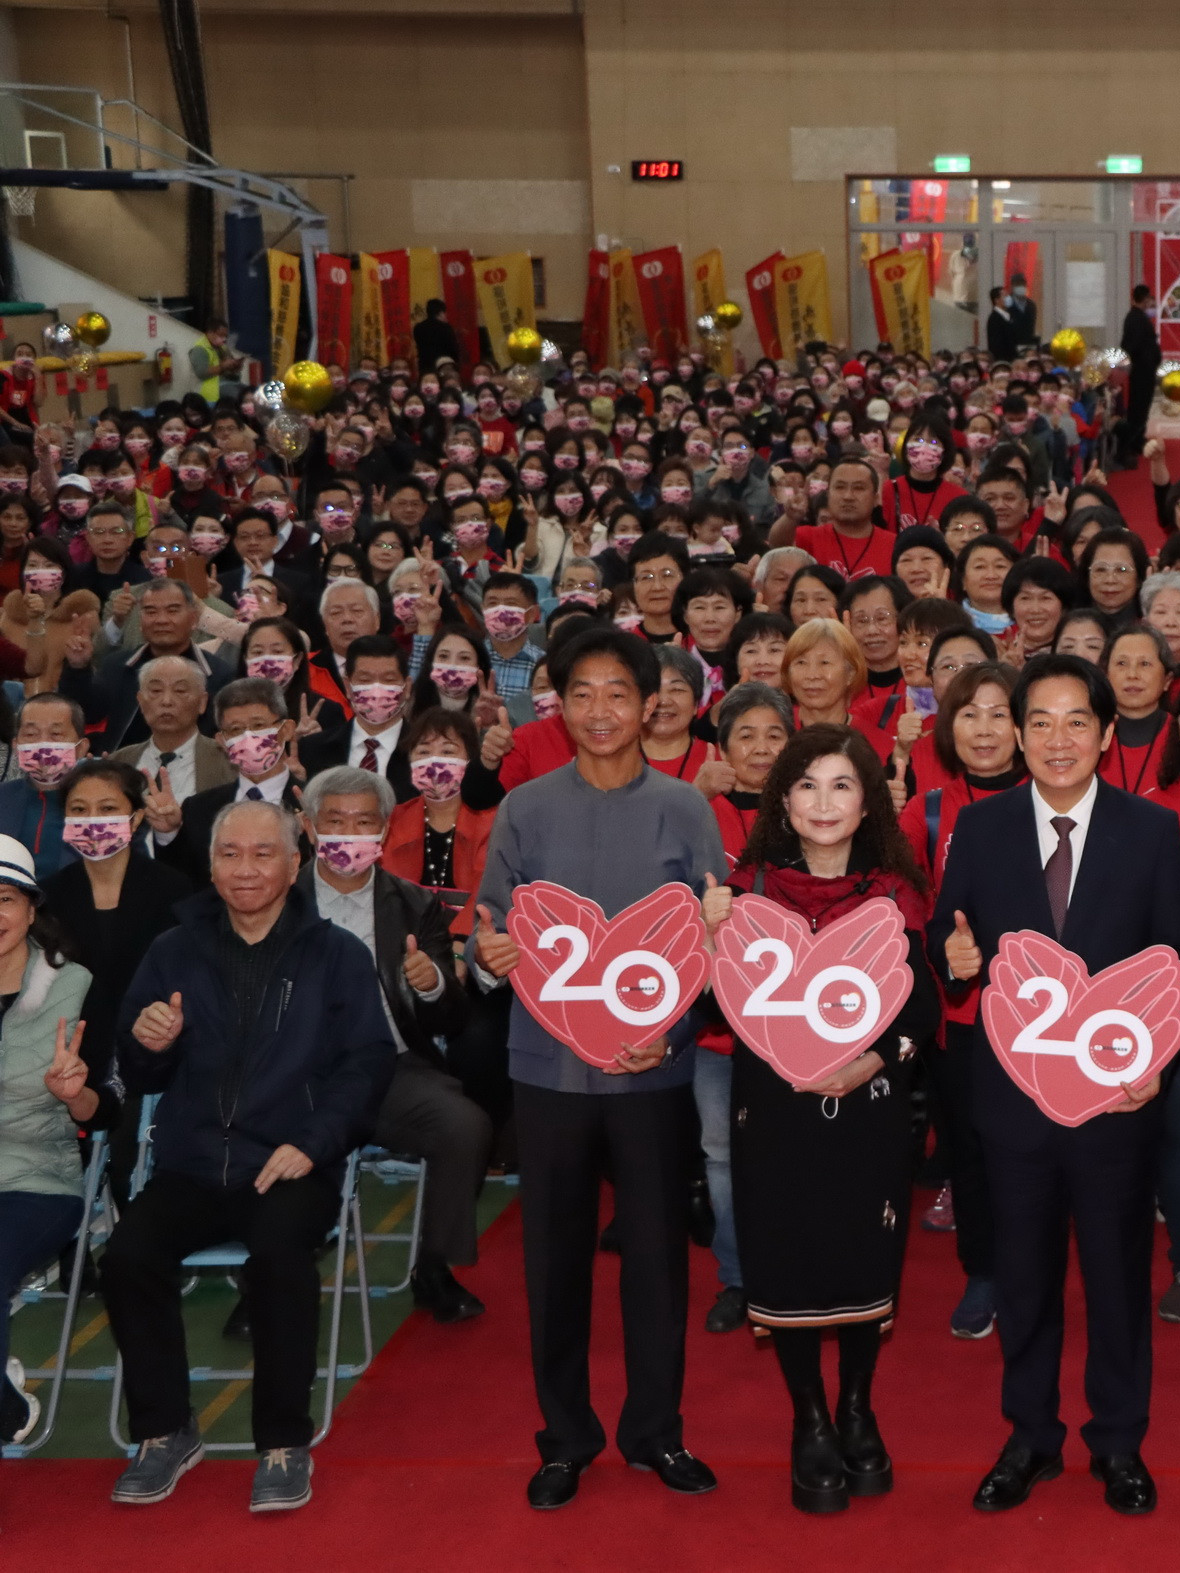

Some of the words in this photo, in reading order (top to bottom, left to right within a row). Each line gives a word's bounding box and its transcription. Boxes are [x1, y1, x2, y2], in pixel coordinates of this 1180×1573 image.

[639, 162, 679, 178] 11:01
[537, 924, 681, 1026] 20
[742, 938, 882, 1044] 20
[1011, 976, 1154, 1087] 20
